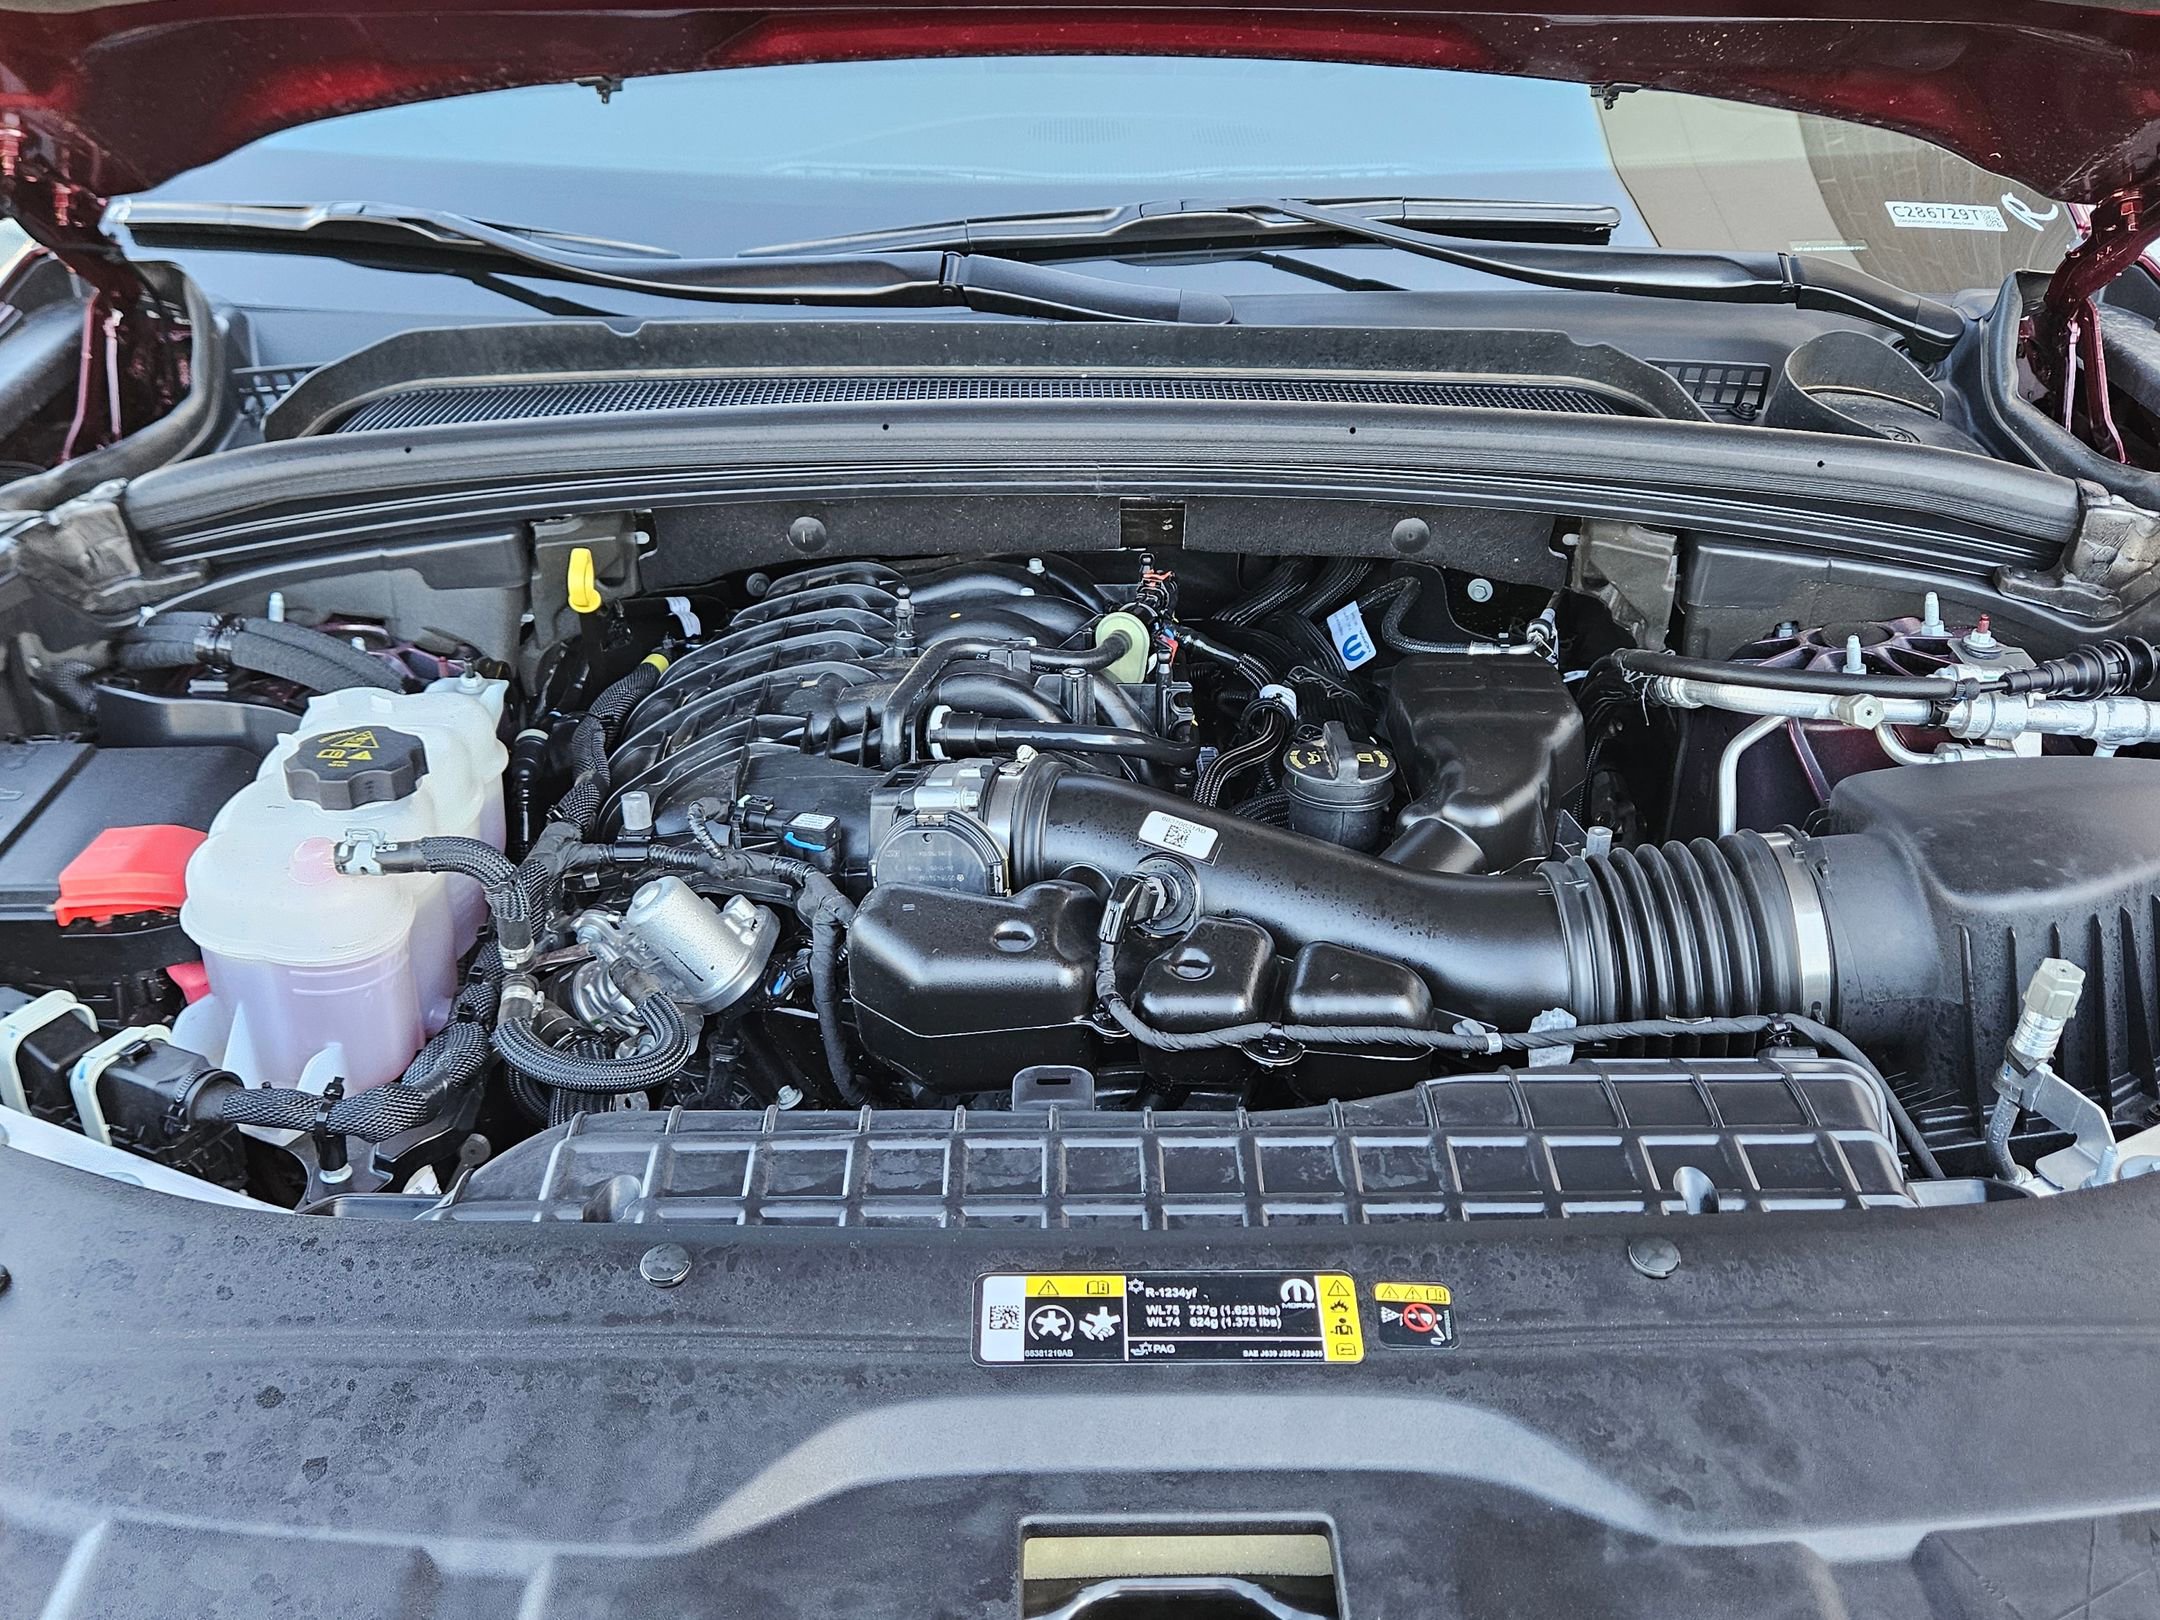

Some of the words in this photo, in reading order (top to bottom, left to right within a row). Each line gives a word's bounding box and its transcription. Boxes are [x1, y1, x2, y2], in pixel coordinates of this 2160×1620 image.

[1892, 205, 1980, 221] C286729T
[1145, 1287, 1197, 1300] R-1234yf
[1146, 1305, 1180, 1315] WL75
[1189, 1305, 1218, 1317] 737g
[1258, 1305, 1281, 1317] lbs)
[1146, 1317, 1181, 1327] WL74
[1189, 1317, 1219, 1329] 624g
[1221, 1317, 1257, 1329] (1.375
[1259, 1317, 1282, 1329] lbs)
[1153, 1344, 1176, 1353] PAG
